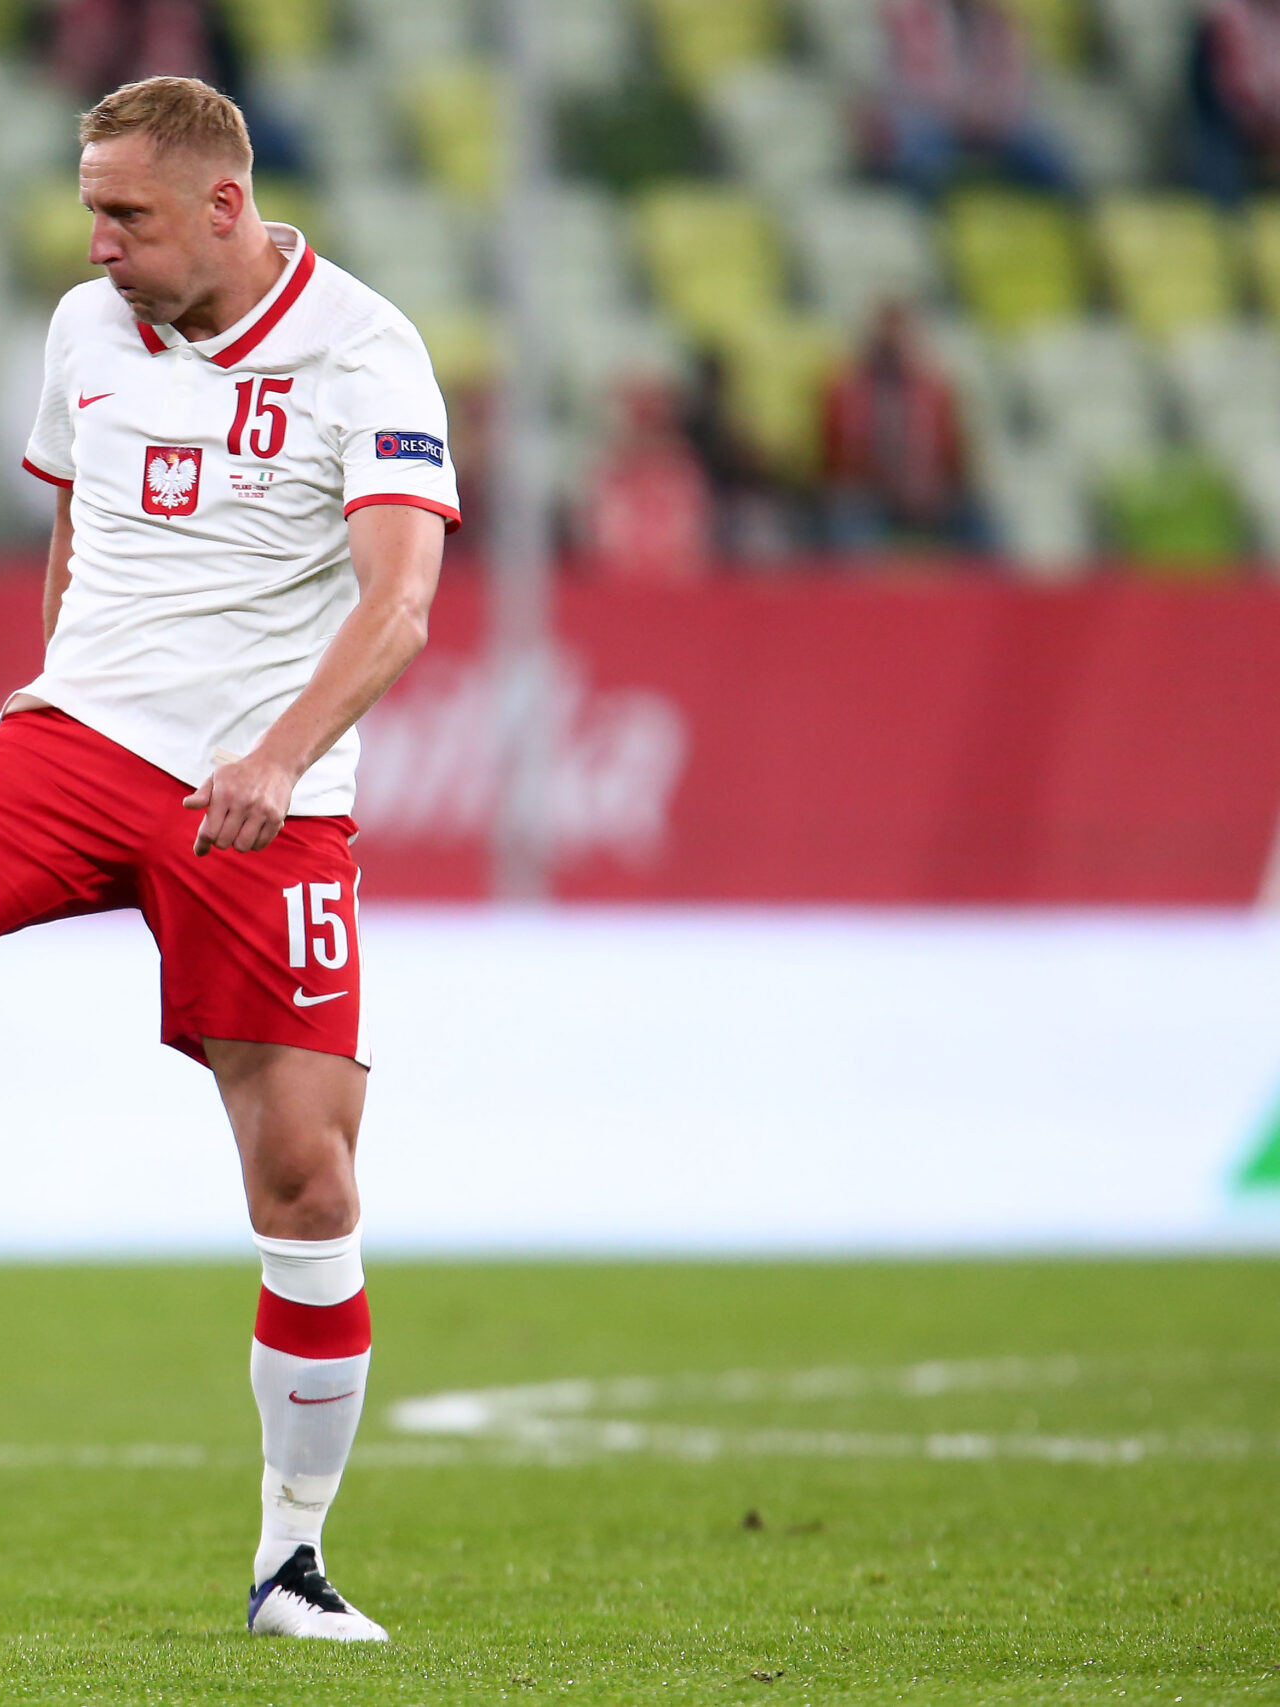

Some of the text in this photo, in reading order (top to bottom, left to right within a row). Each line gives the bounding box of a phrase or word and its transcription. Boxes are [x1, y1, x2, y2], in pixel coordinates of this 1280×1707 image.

[227, 377, 294, 459] 15
[400, 439, 443, 460] RESPECT
[282, 881, 348, 970] 15
